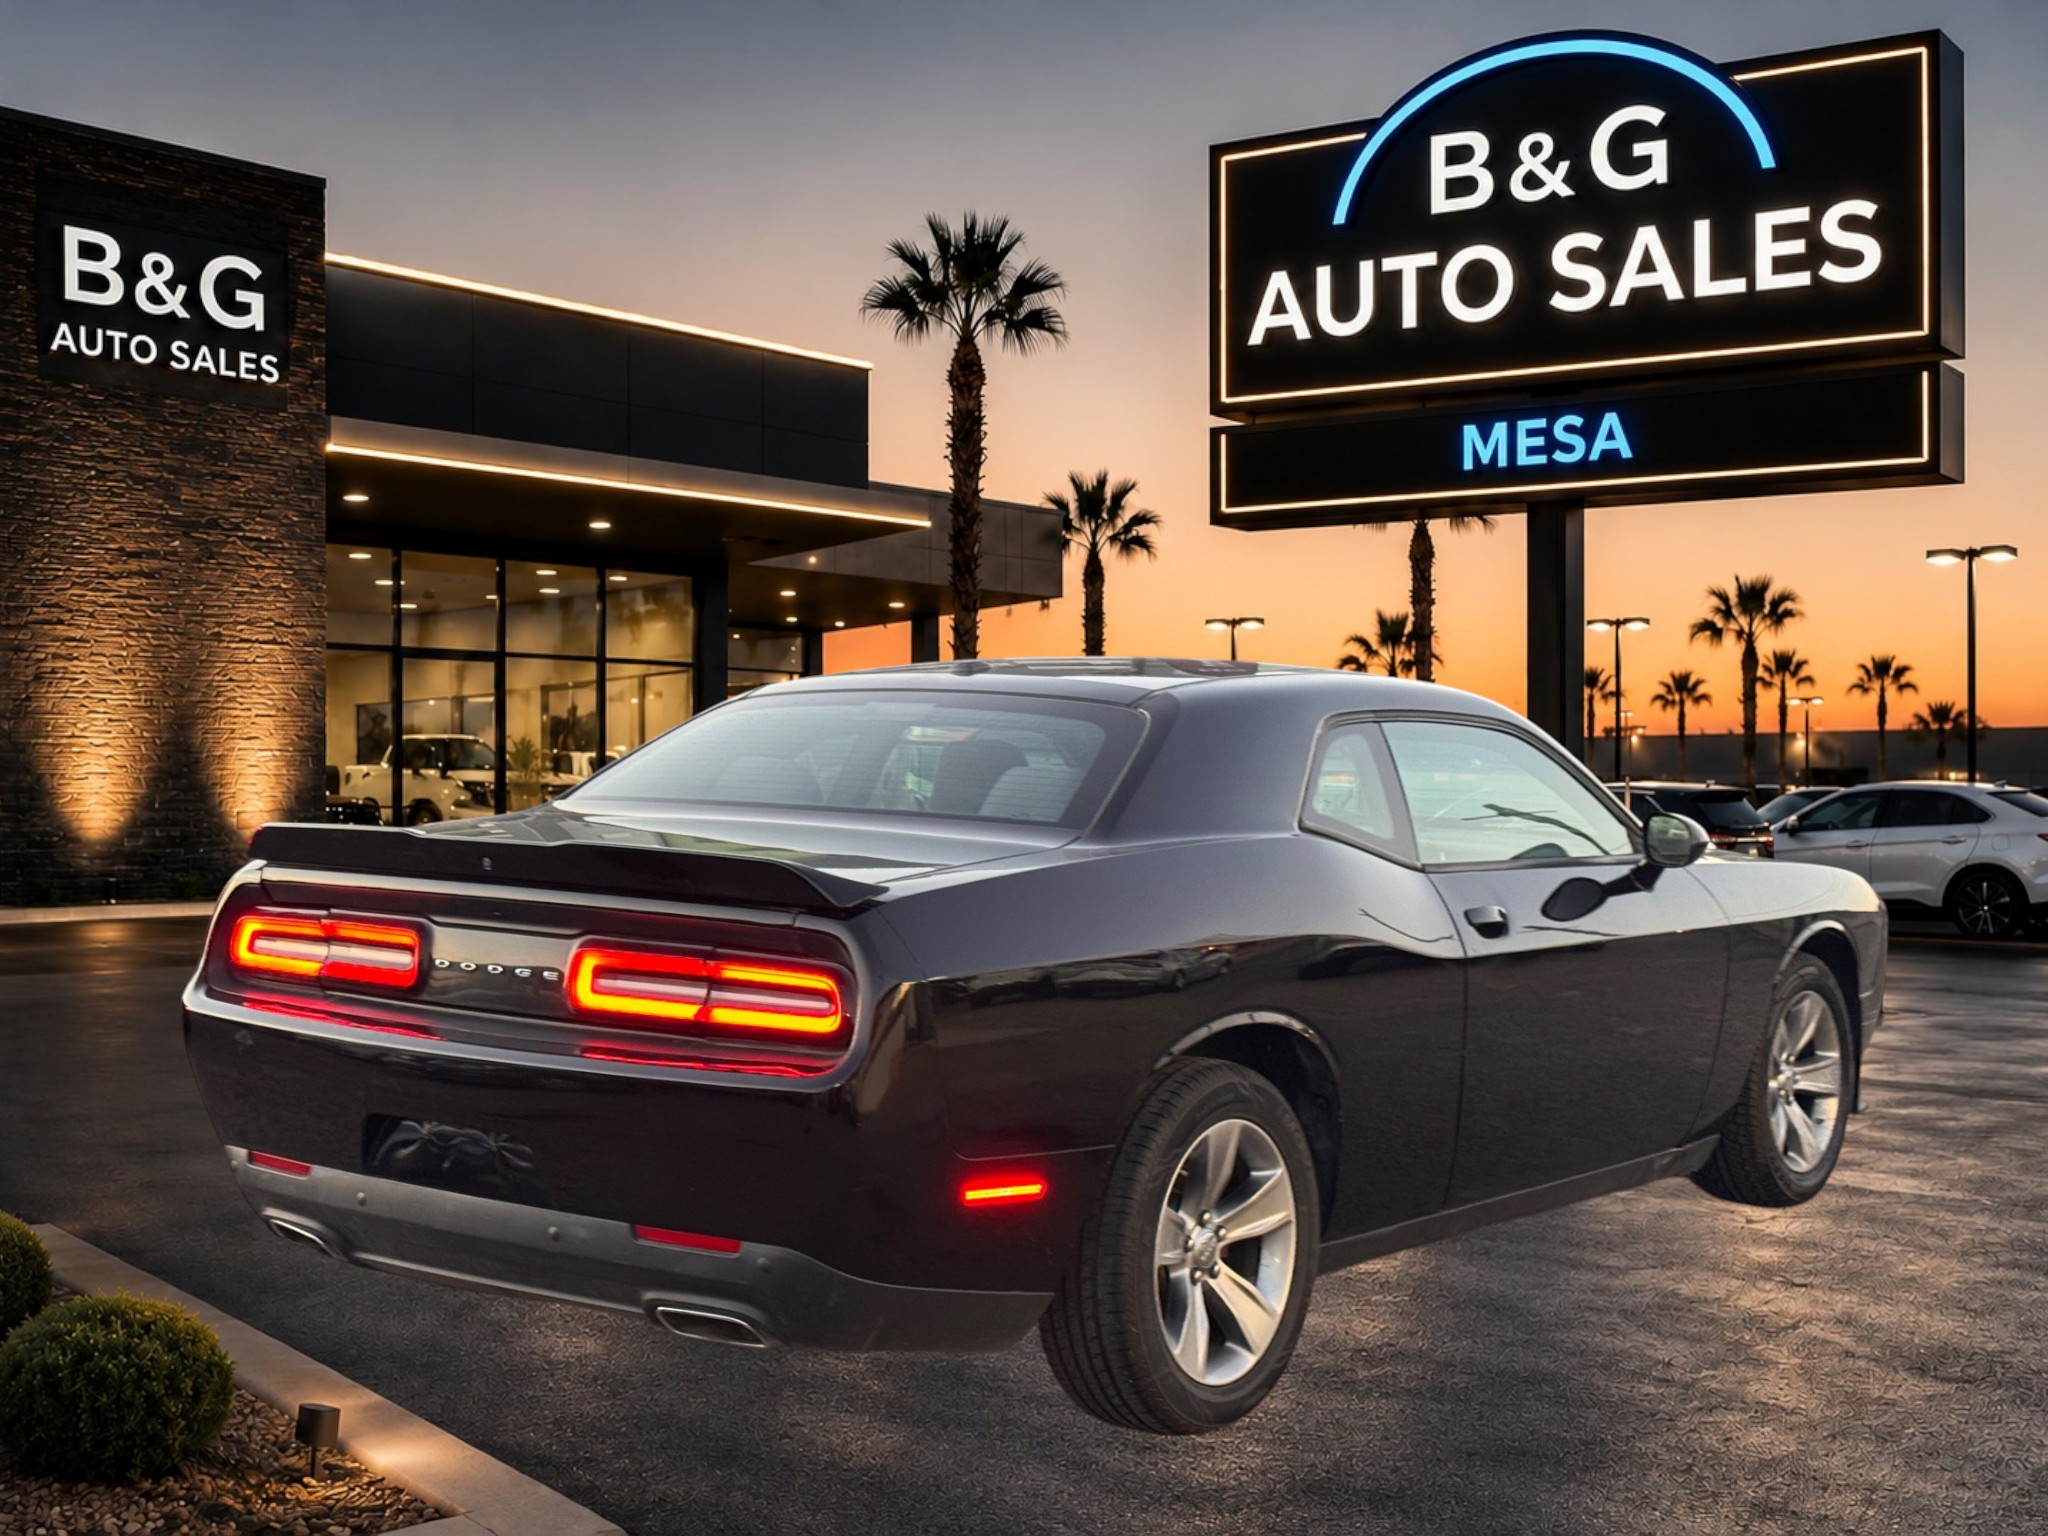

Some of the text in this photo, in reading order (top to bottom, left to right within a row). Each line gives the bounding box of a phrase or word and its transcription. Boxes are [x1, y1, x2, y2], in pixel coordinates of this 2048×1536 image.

[1429, 104, 1670, 216] B&G
[62, 224, 267, 332] B&G
[1246, 199, 1883, 347] AUTO SALES
[50, 322, 281, 385] AUTO SALES
[1462, 411, 1634, 471] MESA
[434, 958, 560, 981] DODGE
